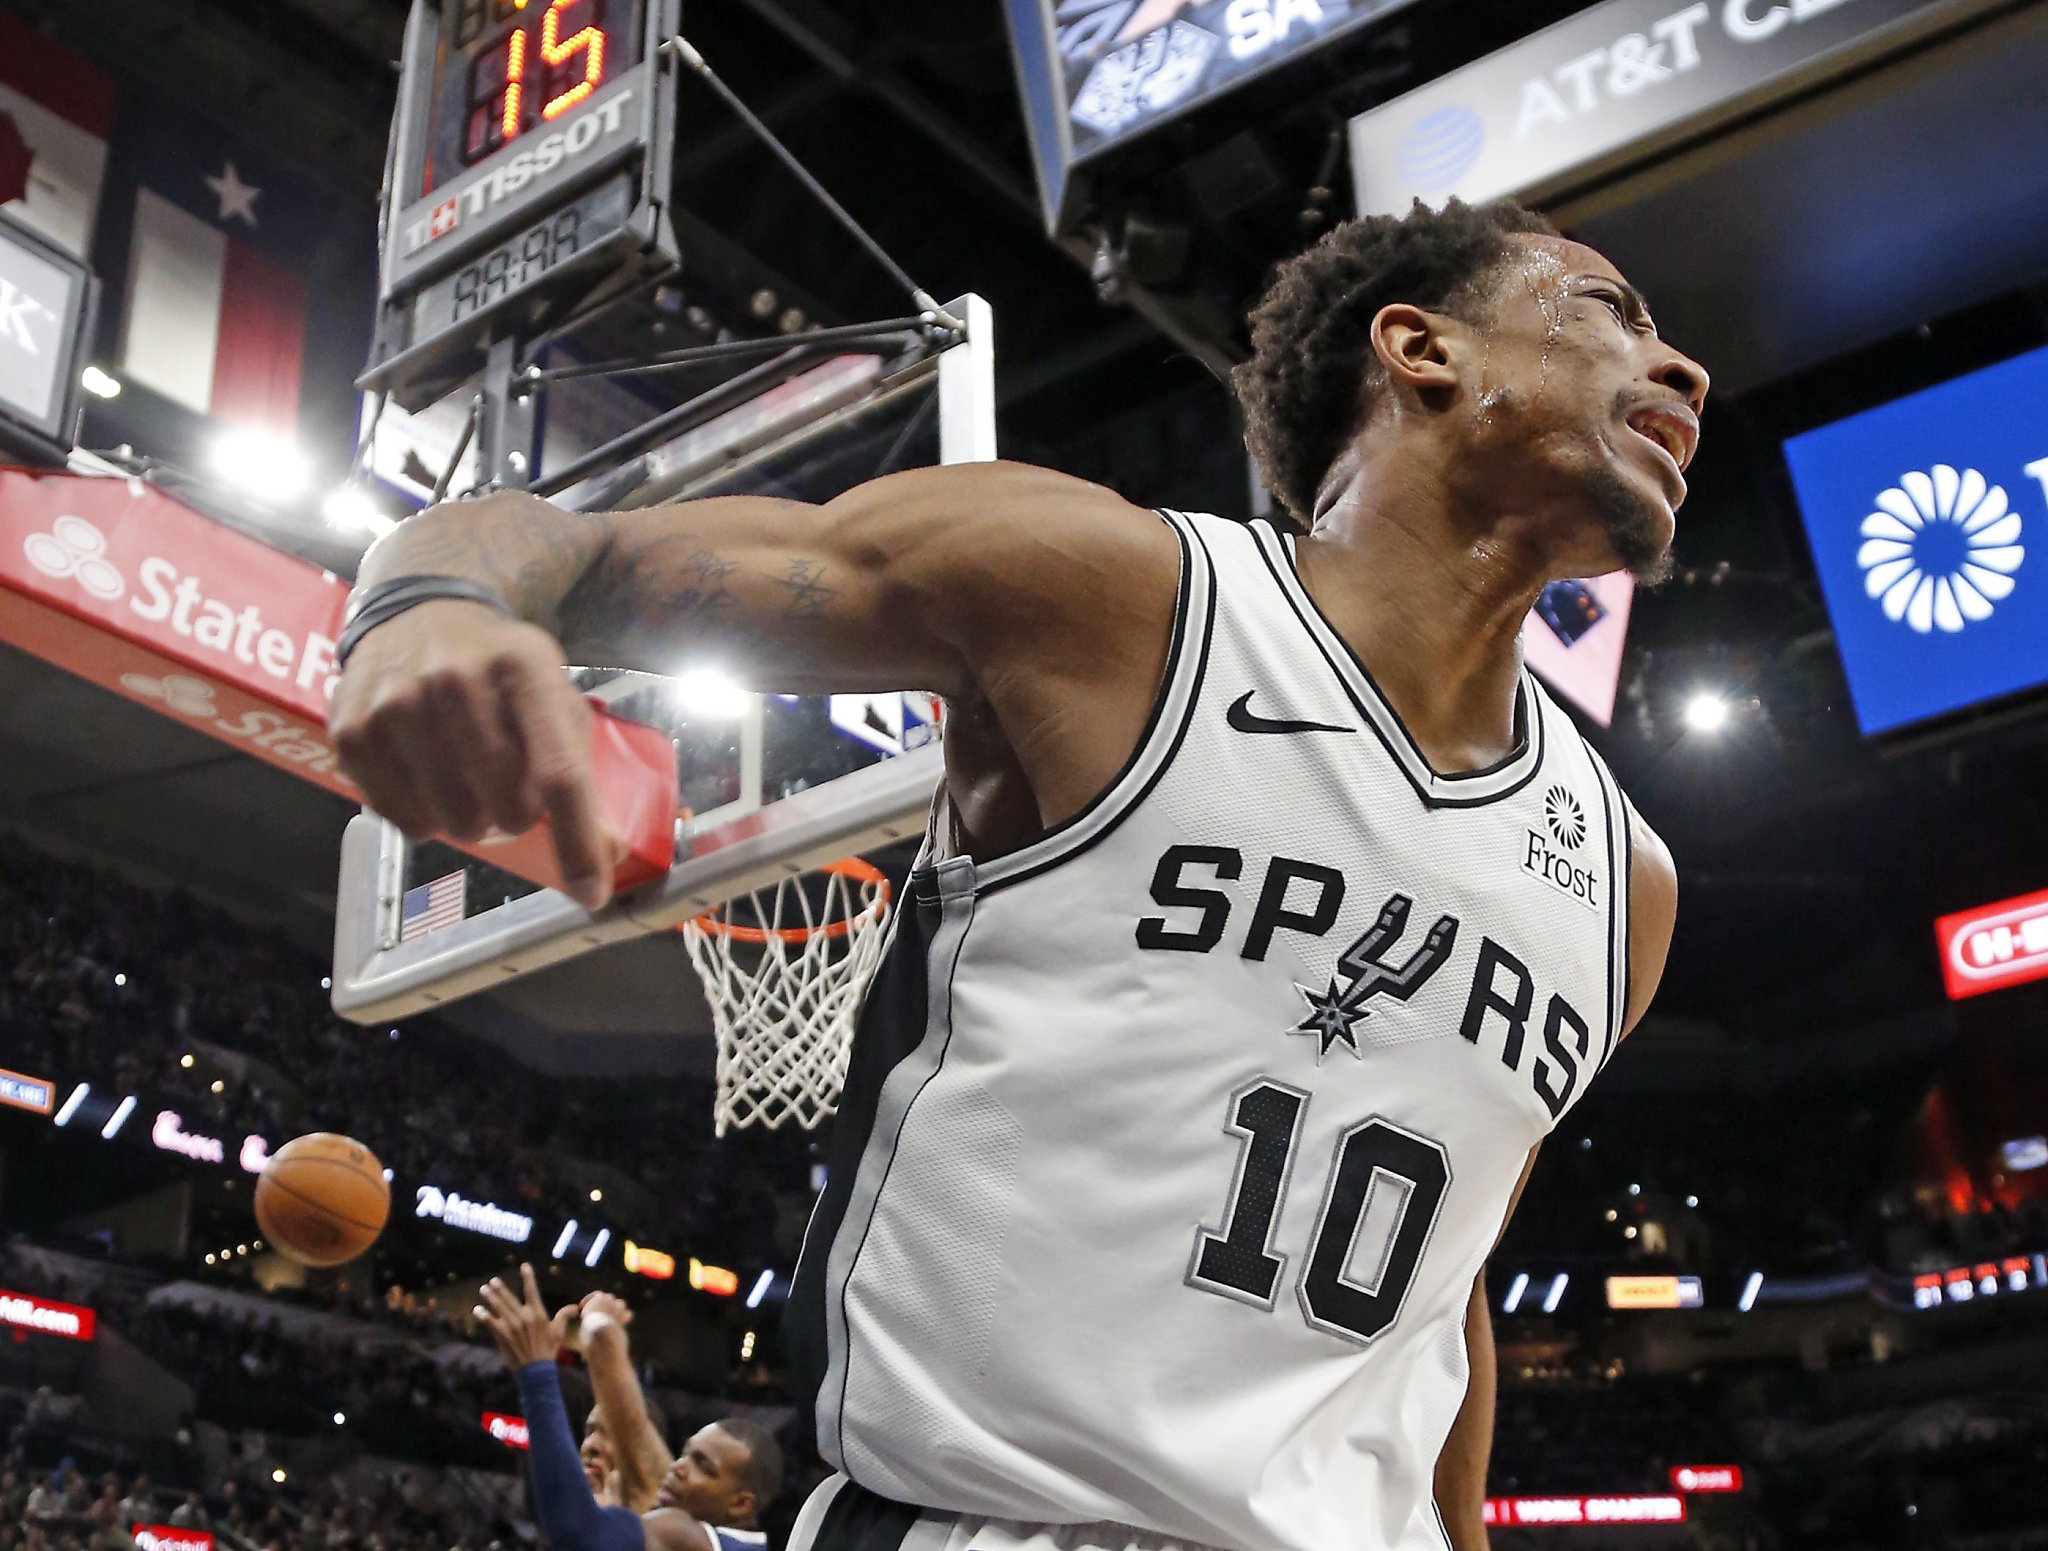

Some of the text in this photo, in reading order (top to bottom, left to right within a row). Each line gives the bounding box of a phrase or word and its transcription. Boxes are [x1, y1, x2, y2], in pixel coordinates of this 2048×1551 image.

[501, 0, 605, 138] 15
[1514, 0, 1849, 142] AT&T C
[460, 88, 633, 217] TISSOT
[130, 555, 294, 680] State
[214, 710, 354, 788] Sta
[1525, 829, 1598, 907] Frost
[1135, 842, 1590, 1120] SPURS
[1183, 1073, 1454, 1348] 10
